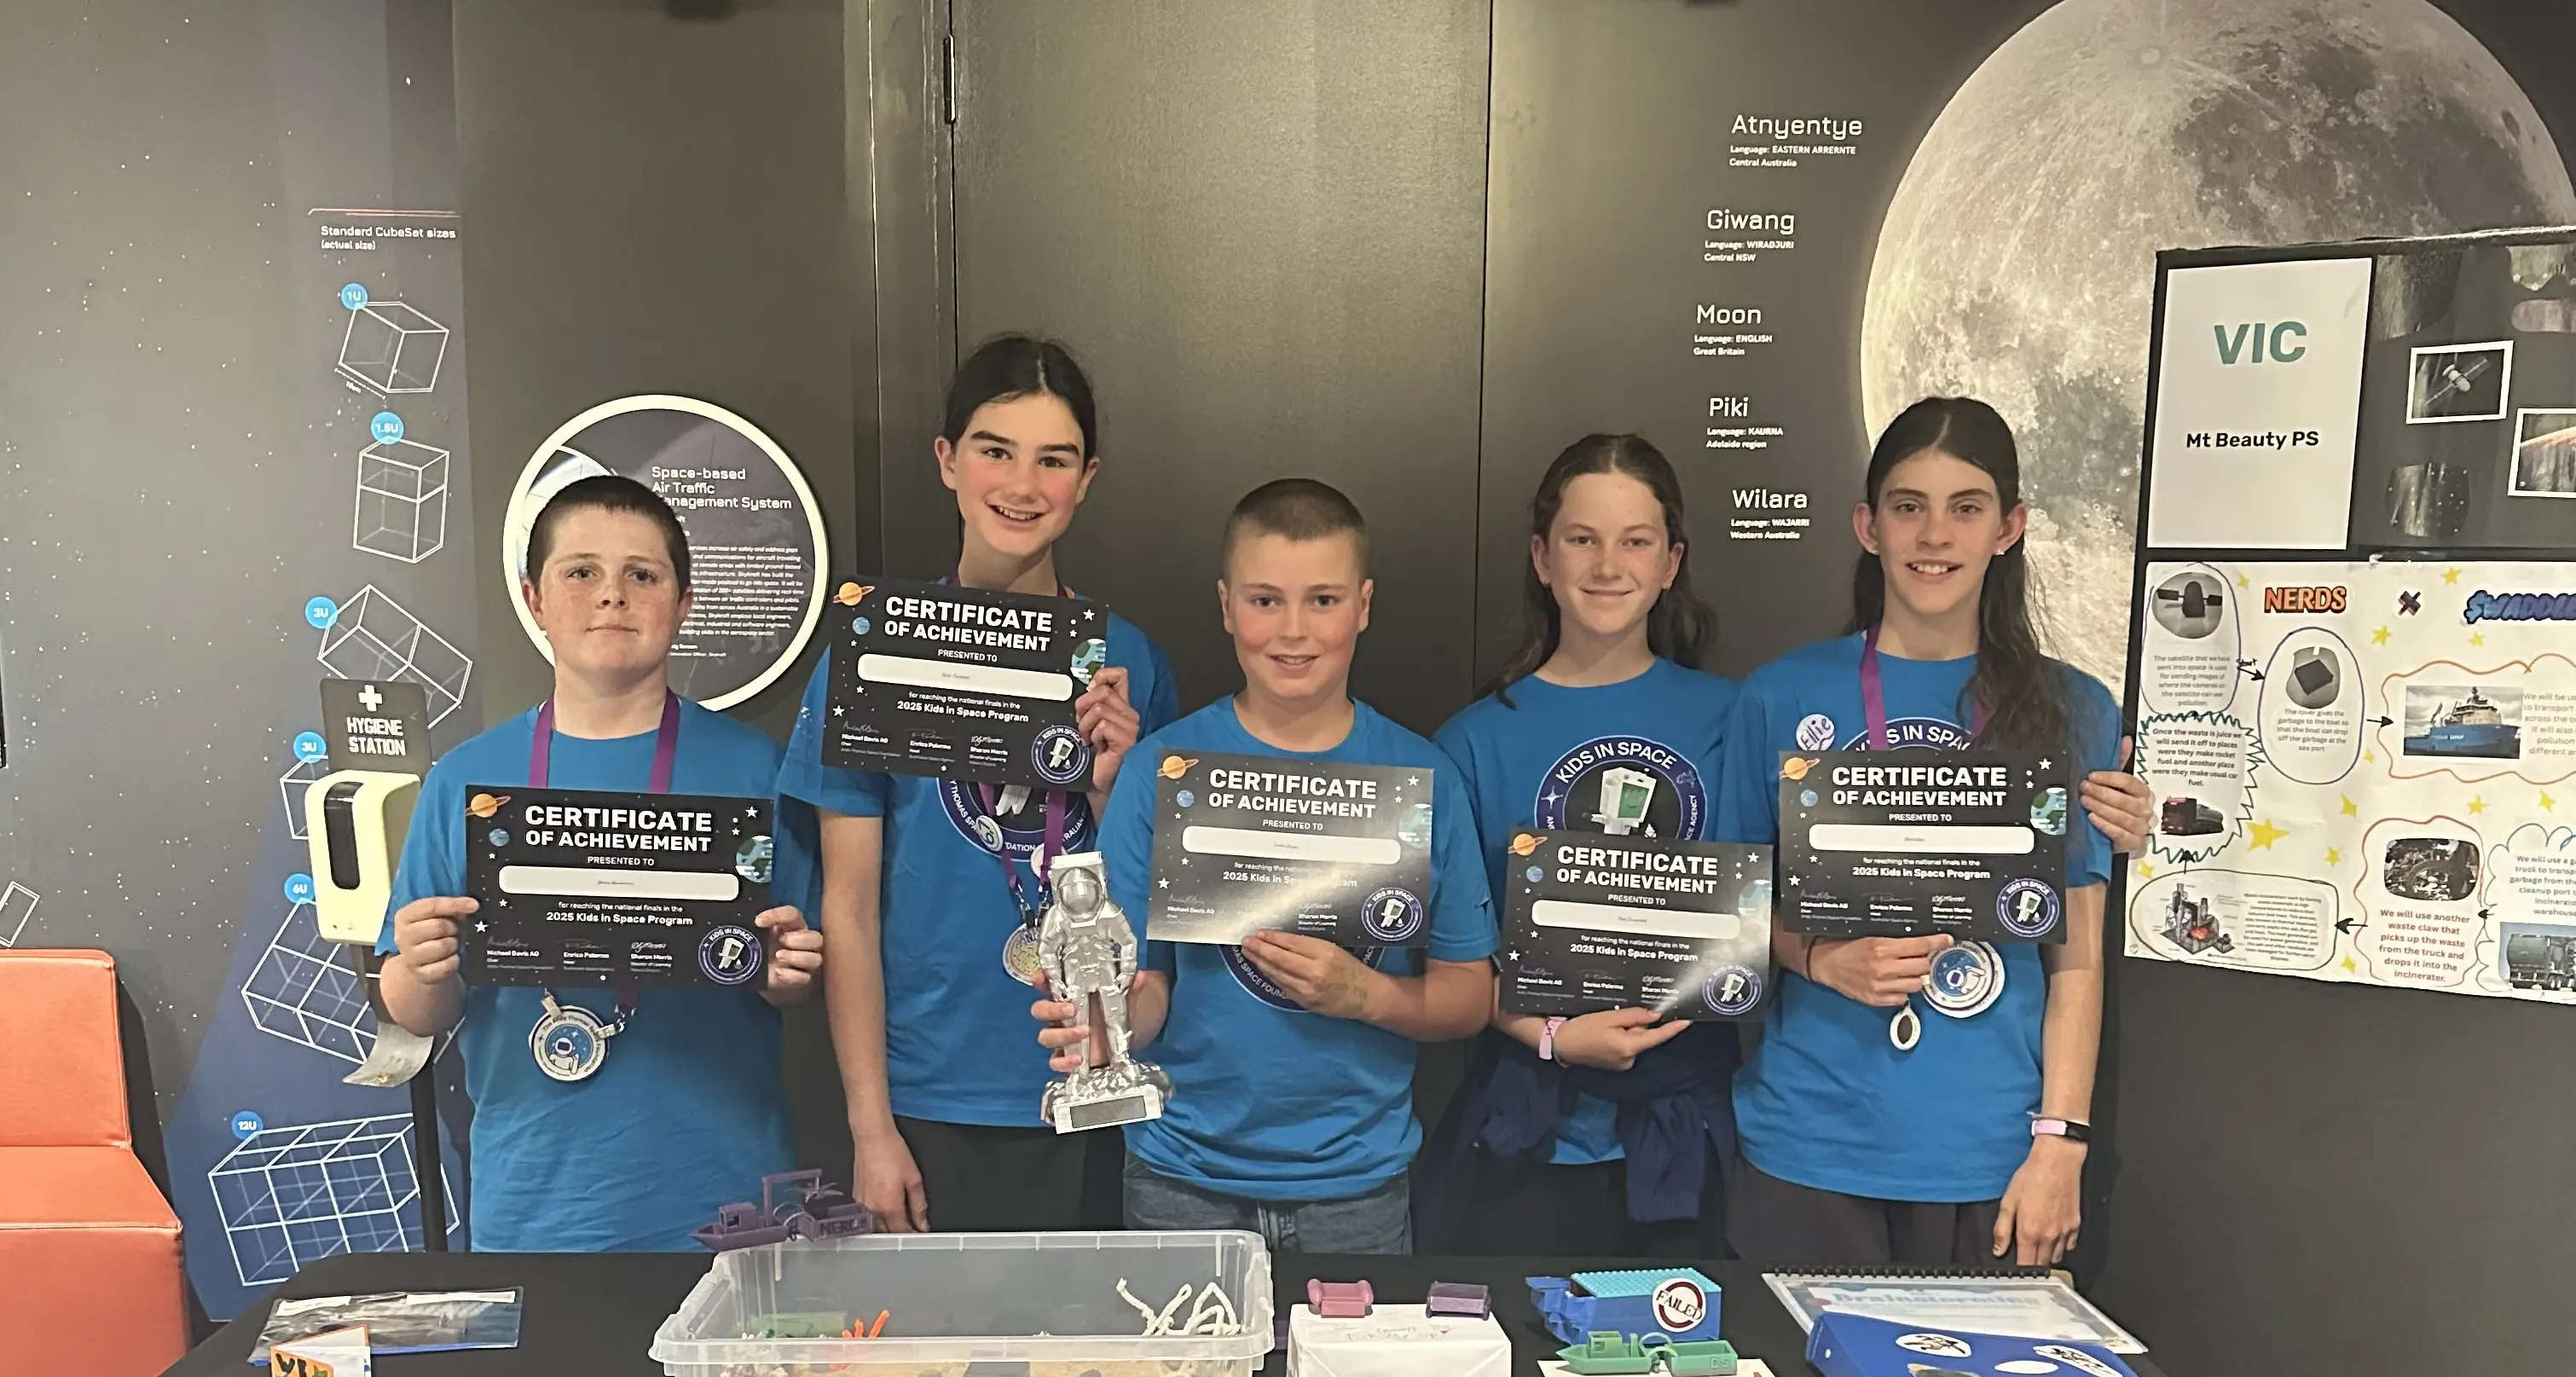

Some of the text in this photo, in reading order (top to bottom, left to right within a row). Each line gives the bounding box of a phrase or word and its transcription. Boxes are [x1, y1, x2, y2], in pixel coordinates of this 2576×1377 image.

[1731, 114, 1862, 140] Atnyentye
[1730, 145, 1769, 154] Language:
[1707, 209, 1794, 234] Giwang
[321, 225, 372, 236] Standard
[427, 228, 456, 238] sizes
[321, 240, 376, 250] (actual size)
[1705, 240, 1794, 250] Language: WIRADJURI
[1705, 253, 1756, 262] Central NSW
[347, 291, 361, 301] 1U
[1697, 304, 1761, 324] Moon
[1694, 334, 1734, 344] Language:
[2214, 321, 2307, 365] VIC
[1693, 347, 1745, 356] Great Britain
[1710, 396, 1748, 417] Piki
[376, 423, 399, 433] 1.5U
[1707, 427, 1746, 437] Language:
[1742, 441, 1767, 449] region
[2186, 431, 2319, 449] Mt Beauty PS
[651, 466, 745, 480] Space-based
[651, 482, 715, 494] Air Traffic
[661, 496, 791, 511] anagement System
[1733, 489, 1808, 508] Wilara
[1731, 519, 1770, 528] Language:
[2264, 586, 2347, 613] NERDS
[314, 608, 328, 617] 2U
[885, 596, 1052, 632] CERTIFICATE
[884, 620, 1051, 651] OF ACHIEVEMENT
[938, 649, 998, 662] PRESENTED TO
[897, 701, 1029, 722] 2025 Kids in Space Program
[347, 717, 403, 736] HYGIENE
[1801, 718, 1832, 749] Ellie
[1902, 725, 1971, 750] IN SPA
[2217, 730, 2232, 738] juice
[350, 736, 406, 755] STATION
[1555, 742, 1677, 784] KIDS IN SPACE
[1210, 769, 1376, 799] CERTIFICATE
[1832, 767, 2006, 787] CERTIFICATE
[950, 785, 968, 819] THOMAS
[1208, 792, 1375, 819] OF ACHIEVEMENT
[1832, 790, 2006, 807] OF ACHIEVEMENT
[525, 806, 712, 832] CERTIFICATE
[1263, 819, 1323, 830] PRESENTED TO
[1941, 813, 1952, 822] TO
[525, 830, 711, 852] OF ACHIEVEMENT
[588, 856, 655, 866] PRESENTED TO
[1557, 846, 1717, 876] CERTIFICATE
[1224, 871, 1247, 881] 2025
[1250, 873, 1270, 882] Kids
[1273, 875, 1281, 883] in
[1556, 868, 1716, 894] OF ACHIEVEMENT
[292, 883, 308, 894] 6U
[570, 902, 600, 911] reaching
[1607, 894, 1665, 905] PRESENTED TO
[547, 912, 692, 926] 2025 Kids in Space Program
[2434, 914, 2470, 923] another
[709, 929, 724, 941] KIDS
[732, 928, 753, 942] SPACE
[1571, 944, 1698, 962] 2025 Kids in Space Program
[2379, 945, 2401, 953] from
[2422, 949, 2446, 958] truck
[2384, 958, 2411, 966] drops
[2423, 960, 2440, 969] into
[2443, 963, 2457, 971] the
[1241, 963, 1261, 986] SPACE
[238, 1120, 257, 1131] 12U
[1656, 1290, 1702, 1320] FAILED
